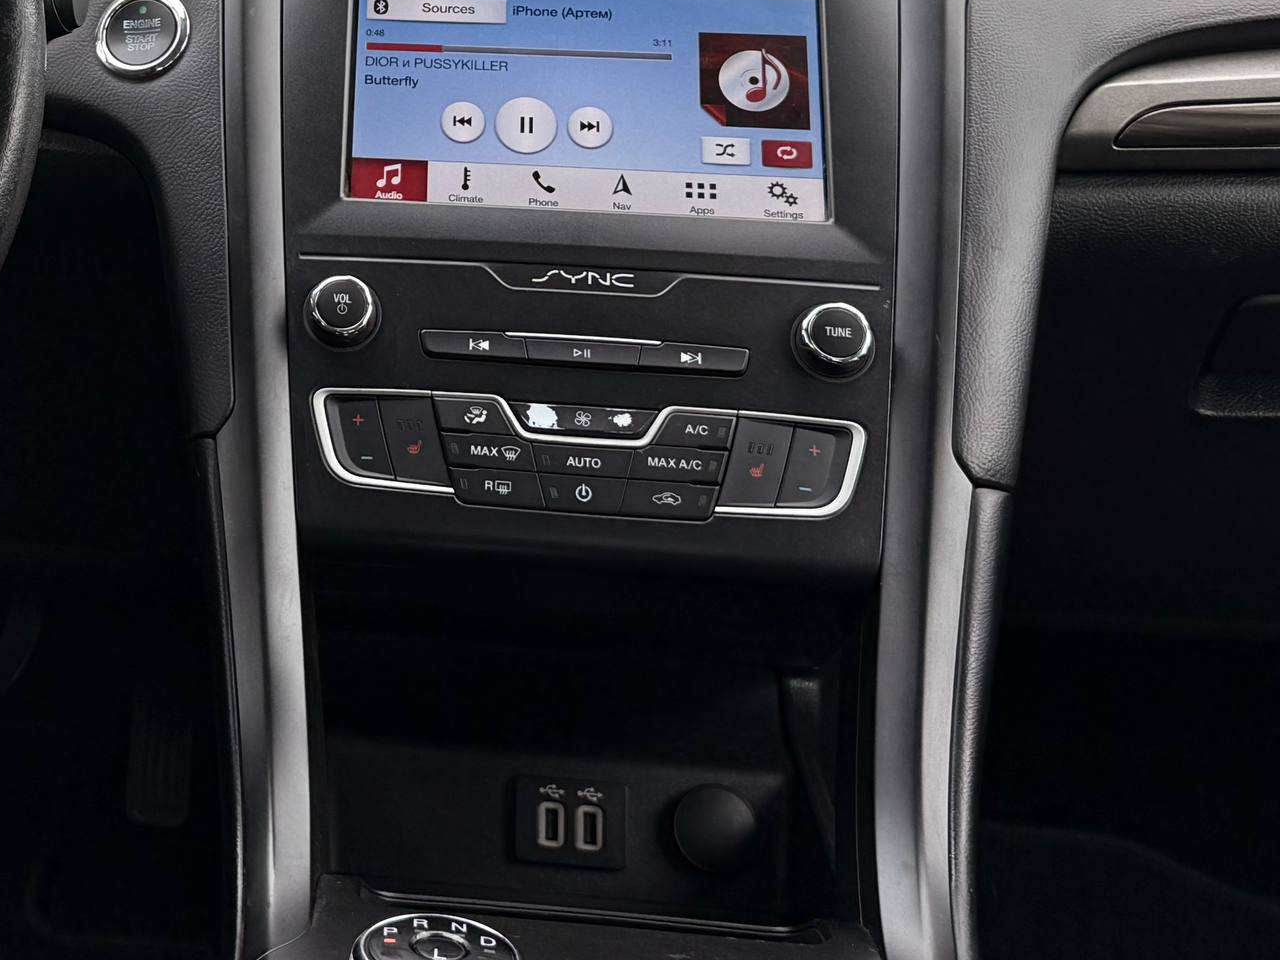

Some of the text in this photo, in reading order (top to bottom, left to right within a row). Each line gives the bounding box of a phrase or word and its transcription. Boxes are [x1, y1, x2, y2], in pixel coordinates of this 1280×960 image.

[422, 2, 475, 15] Sources
[512, 5, 558, 17] iPhone
[123, 18, 161, 29] ENGINE
[365, 28, 385, 37] 0:48
[125, 33, 159, 44] START
[652, 38, 672, 47] 3:11
[127, 42, 156, 51] STOP
[365, 56, 399, 68] DIOR
[414, 58, 509, 72] PUSSYKILLER
[364, 74, 419, 88] Butterfly
[375, 190, 403, 200] Audio
[448, 193, 484, 204] Climate
[528, 197, 559, 207] Phone
[613, 202, 632, 211] Nav
[689, 206, 715, 216] Apps
[763, 209, 804, 220] Settings
[531, 270, 635, 287] SYNC
[333, 293, 352, 304] VOL
[824, 326, 853, 338] TUNE
[684, 424, 709, 436] A/C
[469, 445, 499, 457] MAX
[566, 456, 601, 469] AUTO
[647, 457, 703, 471] MAX A/C
[484, 480, 494, 491] R
[413, 919, 429, 928] R
[451, 922, 468, 932] N
[383, 927, 398, 936] P
[480, 936, 496, 946] D
